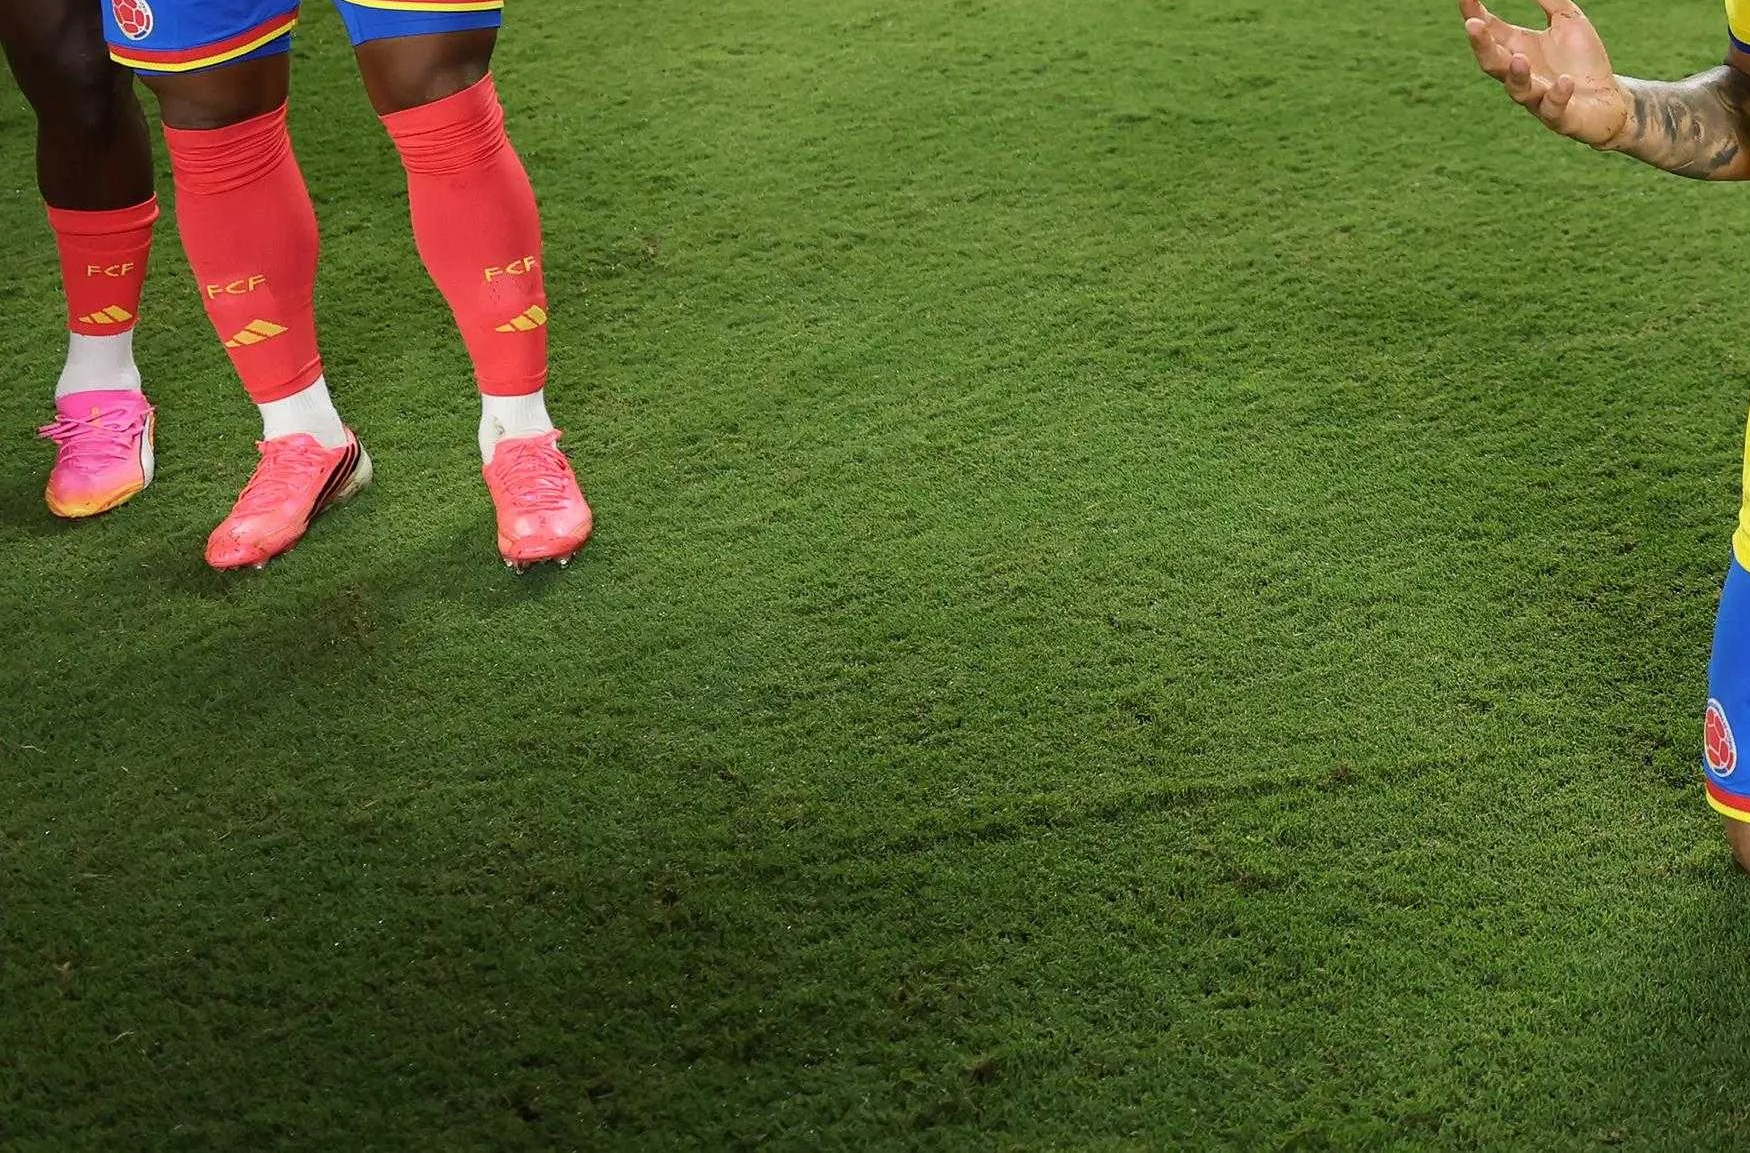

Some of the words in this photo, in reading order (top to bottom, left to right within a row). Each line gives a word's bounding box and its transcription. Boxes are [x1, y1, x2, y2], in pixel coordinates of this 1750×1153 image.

[87, 262, 134, 277] FCF
[484, 255, 536, 282] FCF
[207, 274, 266, 300] FCF
